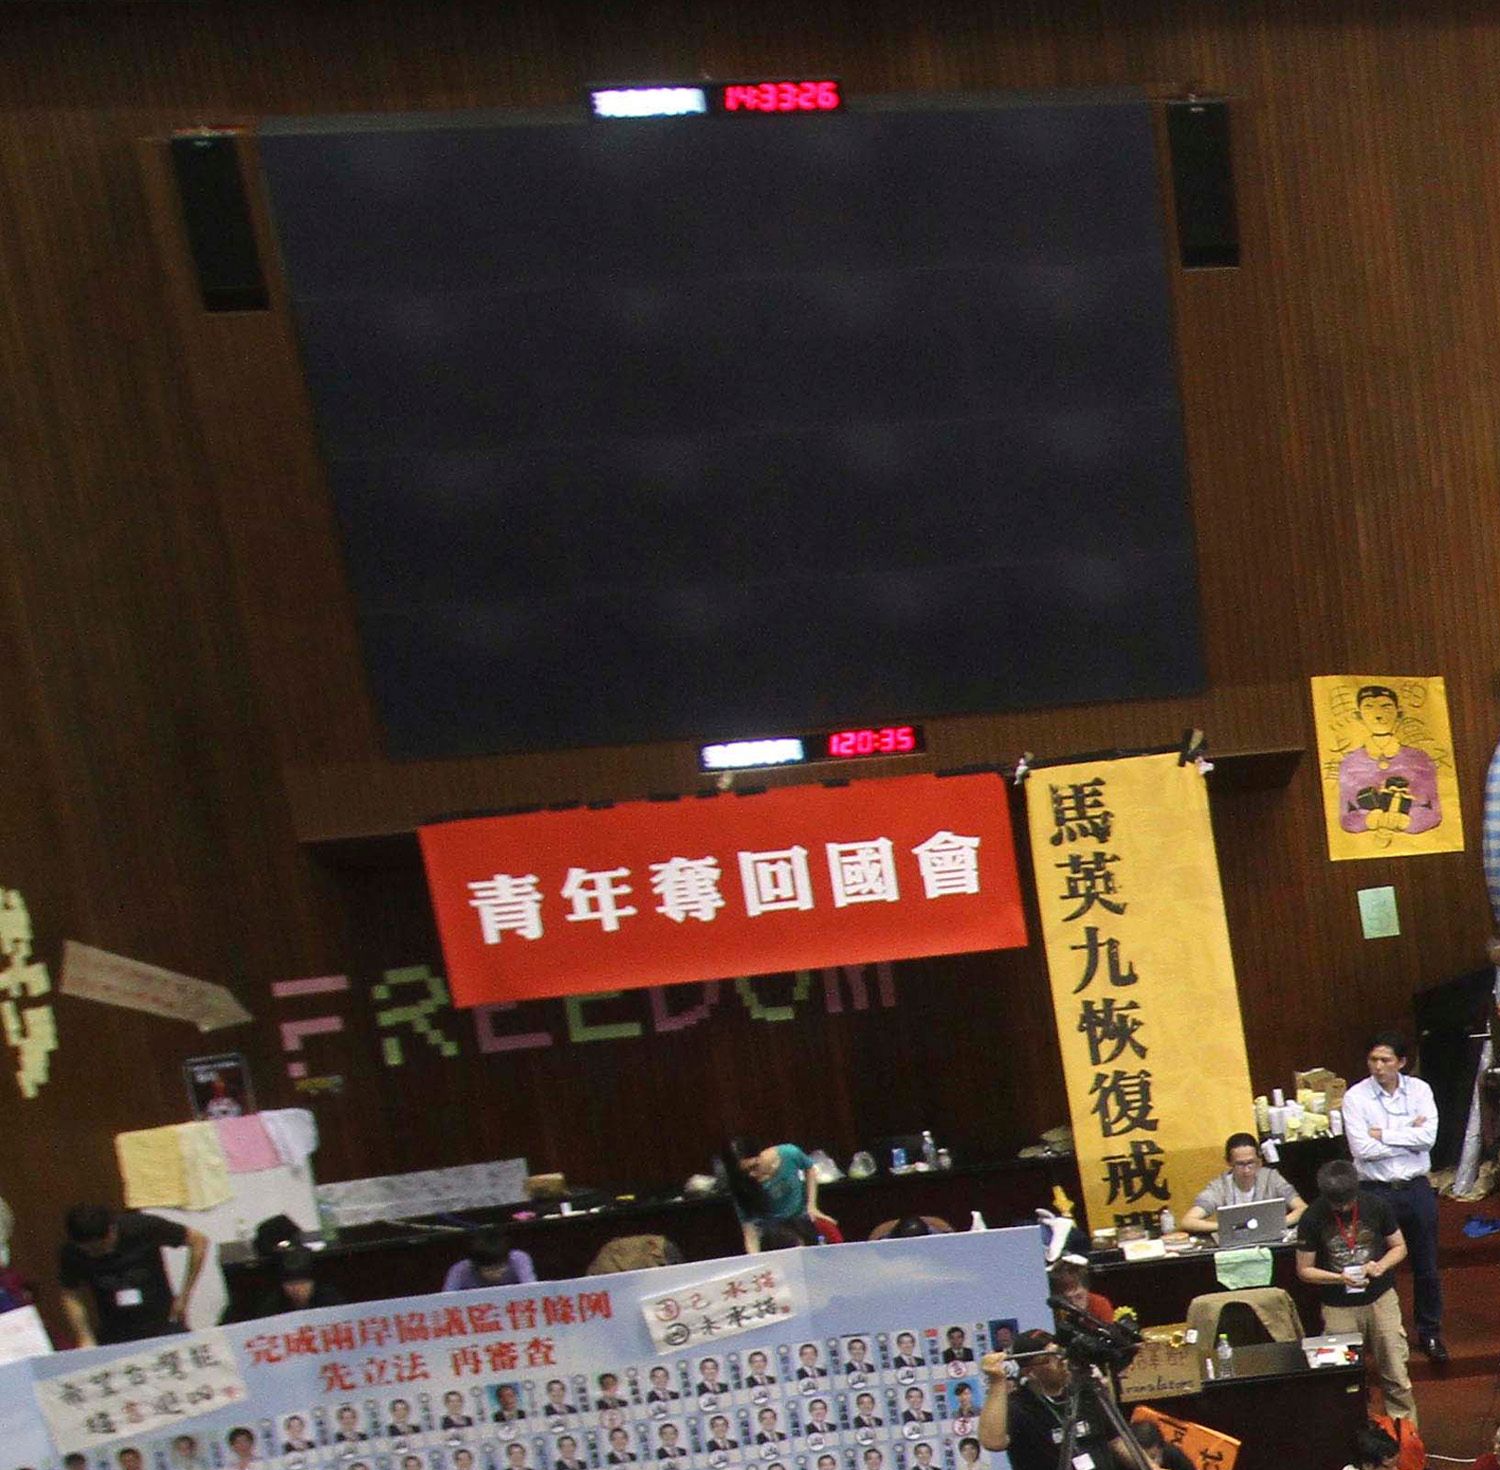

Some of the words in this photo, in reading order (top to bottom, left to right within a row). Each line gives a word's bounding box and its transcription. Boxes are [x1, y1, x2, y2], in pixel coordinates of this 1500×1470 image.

[725, 81, 839, 112] 14:33:26
[829, 725, 915, 758] 120:35
[468, 829, 982, 946] 青年奪回國會
[319, 1350, 430, 1392] 先立法
[451, 1336, 558, 1379] 再審查
